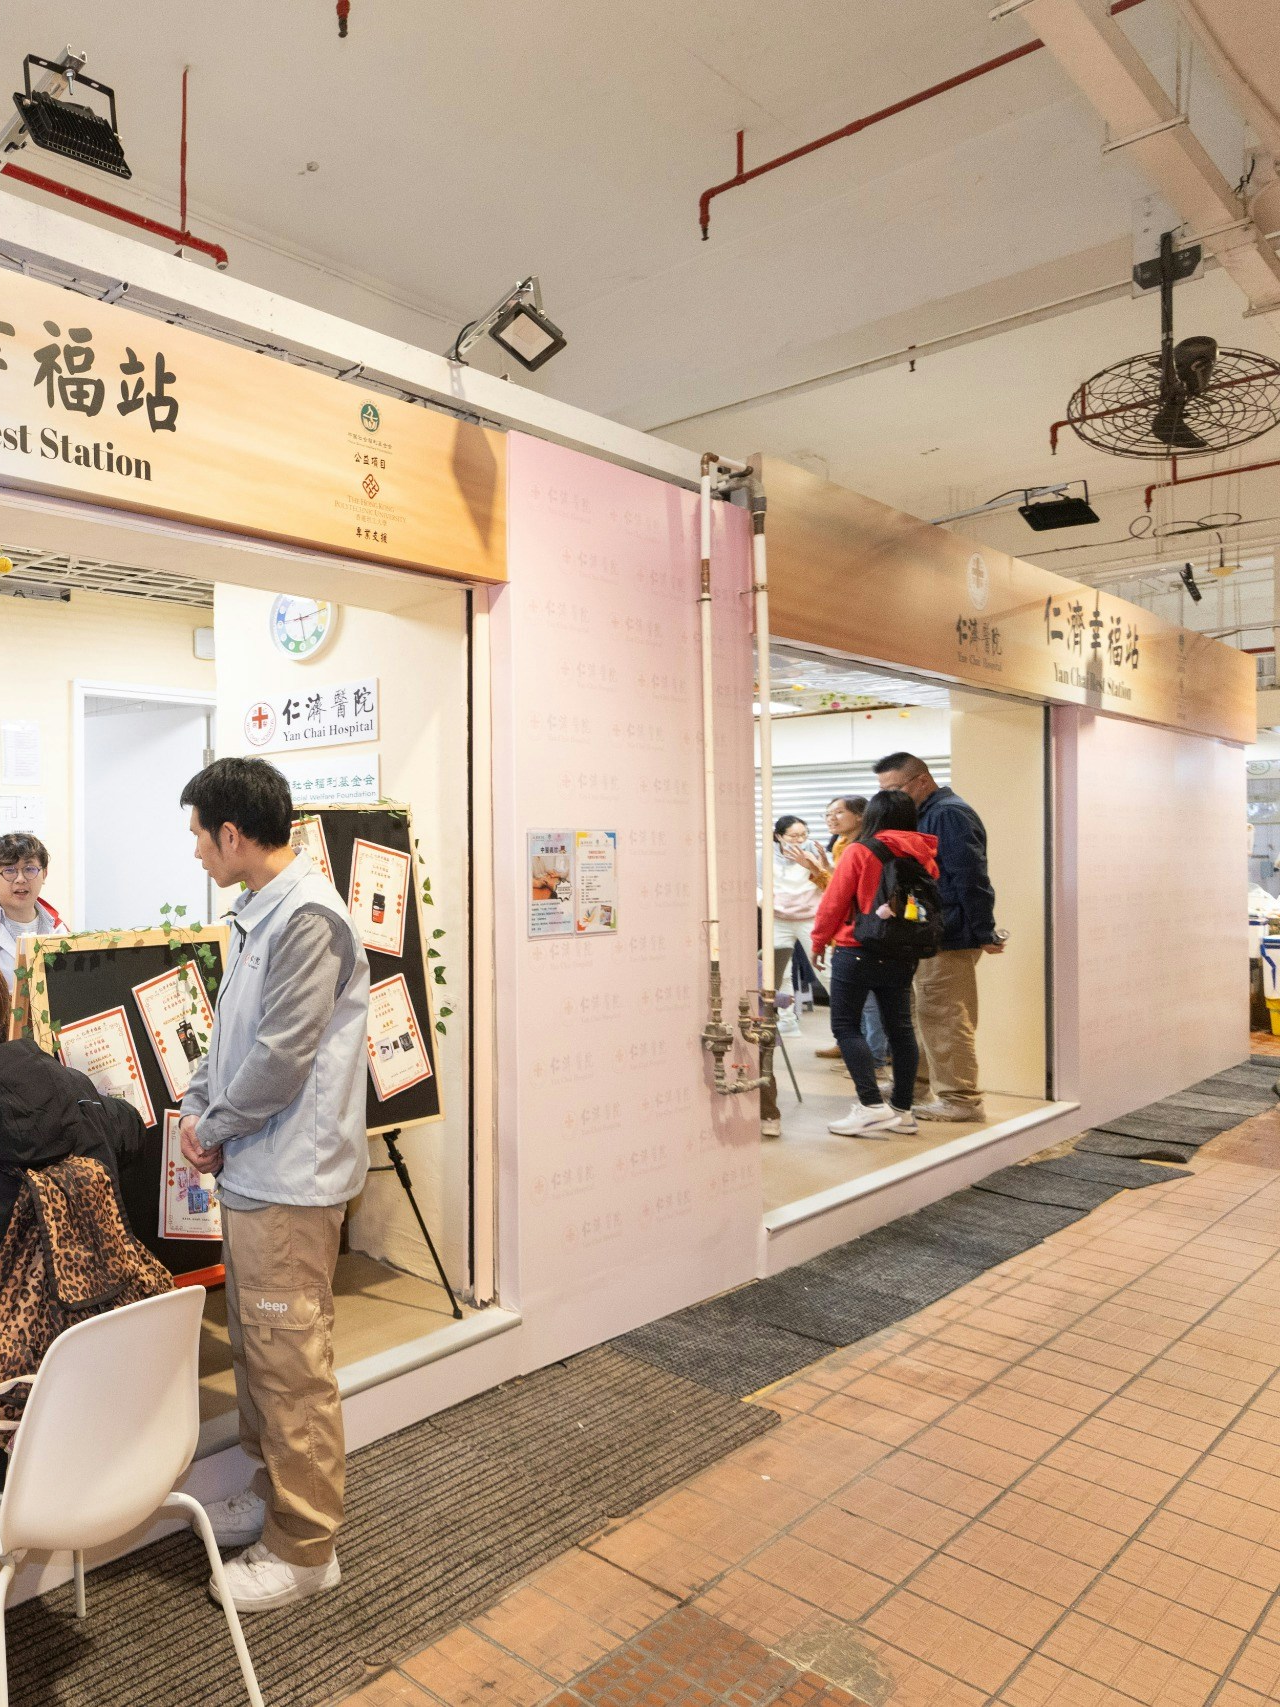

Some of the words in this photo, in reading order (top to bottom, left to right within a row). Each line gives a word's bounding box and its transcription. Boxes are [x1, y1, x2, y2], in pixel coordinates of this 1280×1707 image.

[41, 427, 152, 481] Station
[282, 687, 374, 725] 仁濟醫院
[283, 731, 300, 742] Yan
[303, 726, 326, 739] Chai
[329, 719, 373, 737] Hospital
[291, 791, 308, 801] ocial
[310, 791, 335, 801] Welfare
[336, 790, 376, 800] Foundation
[256, 1298, 288, 1313] Jeep
